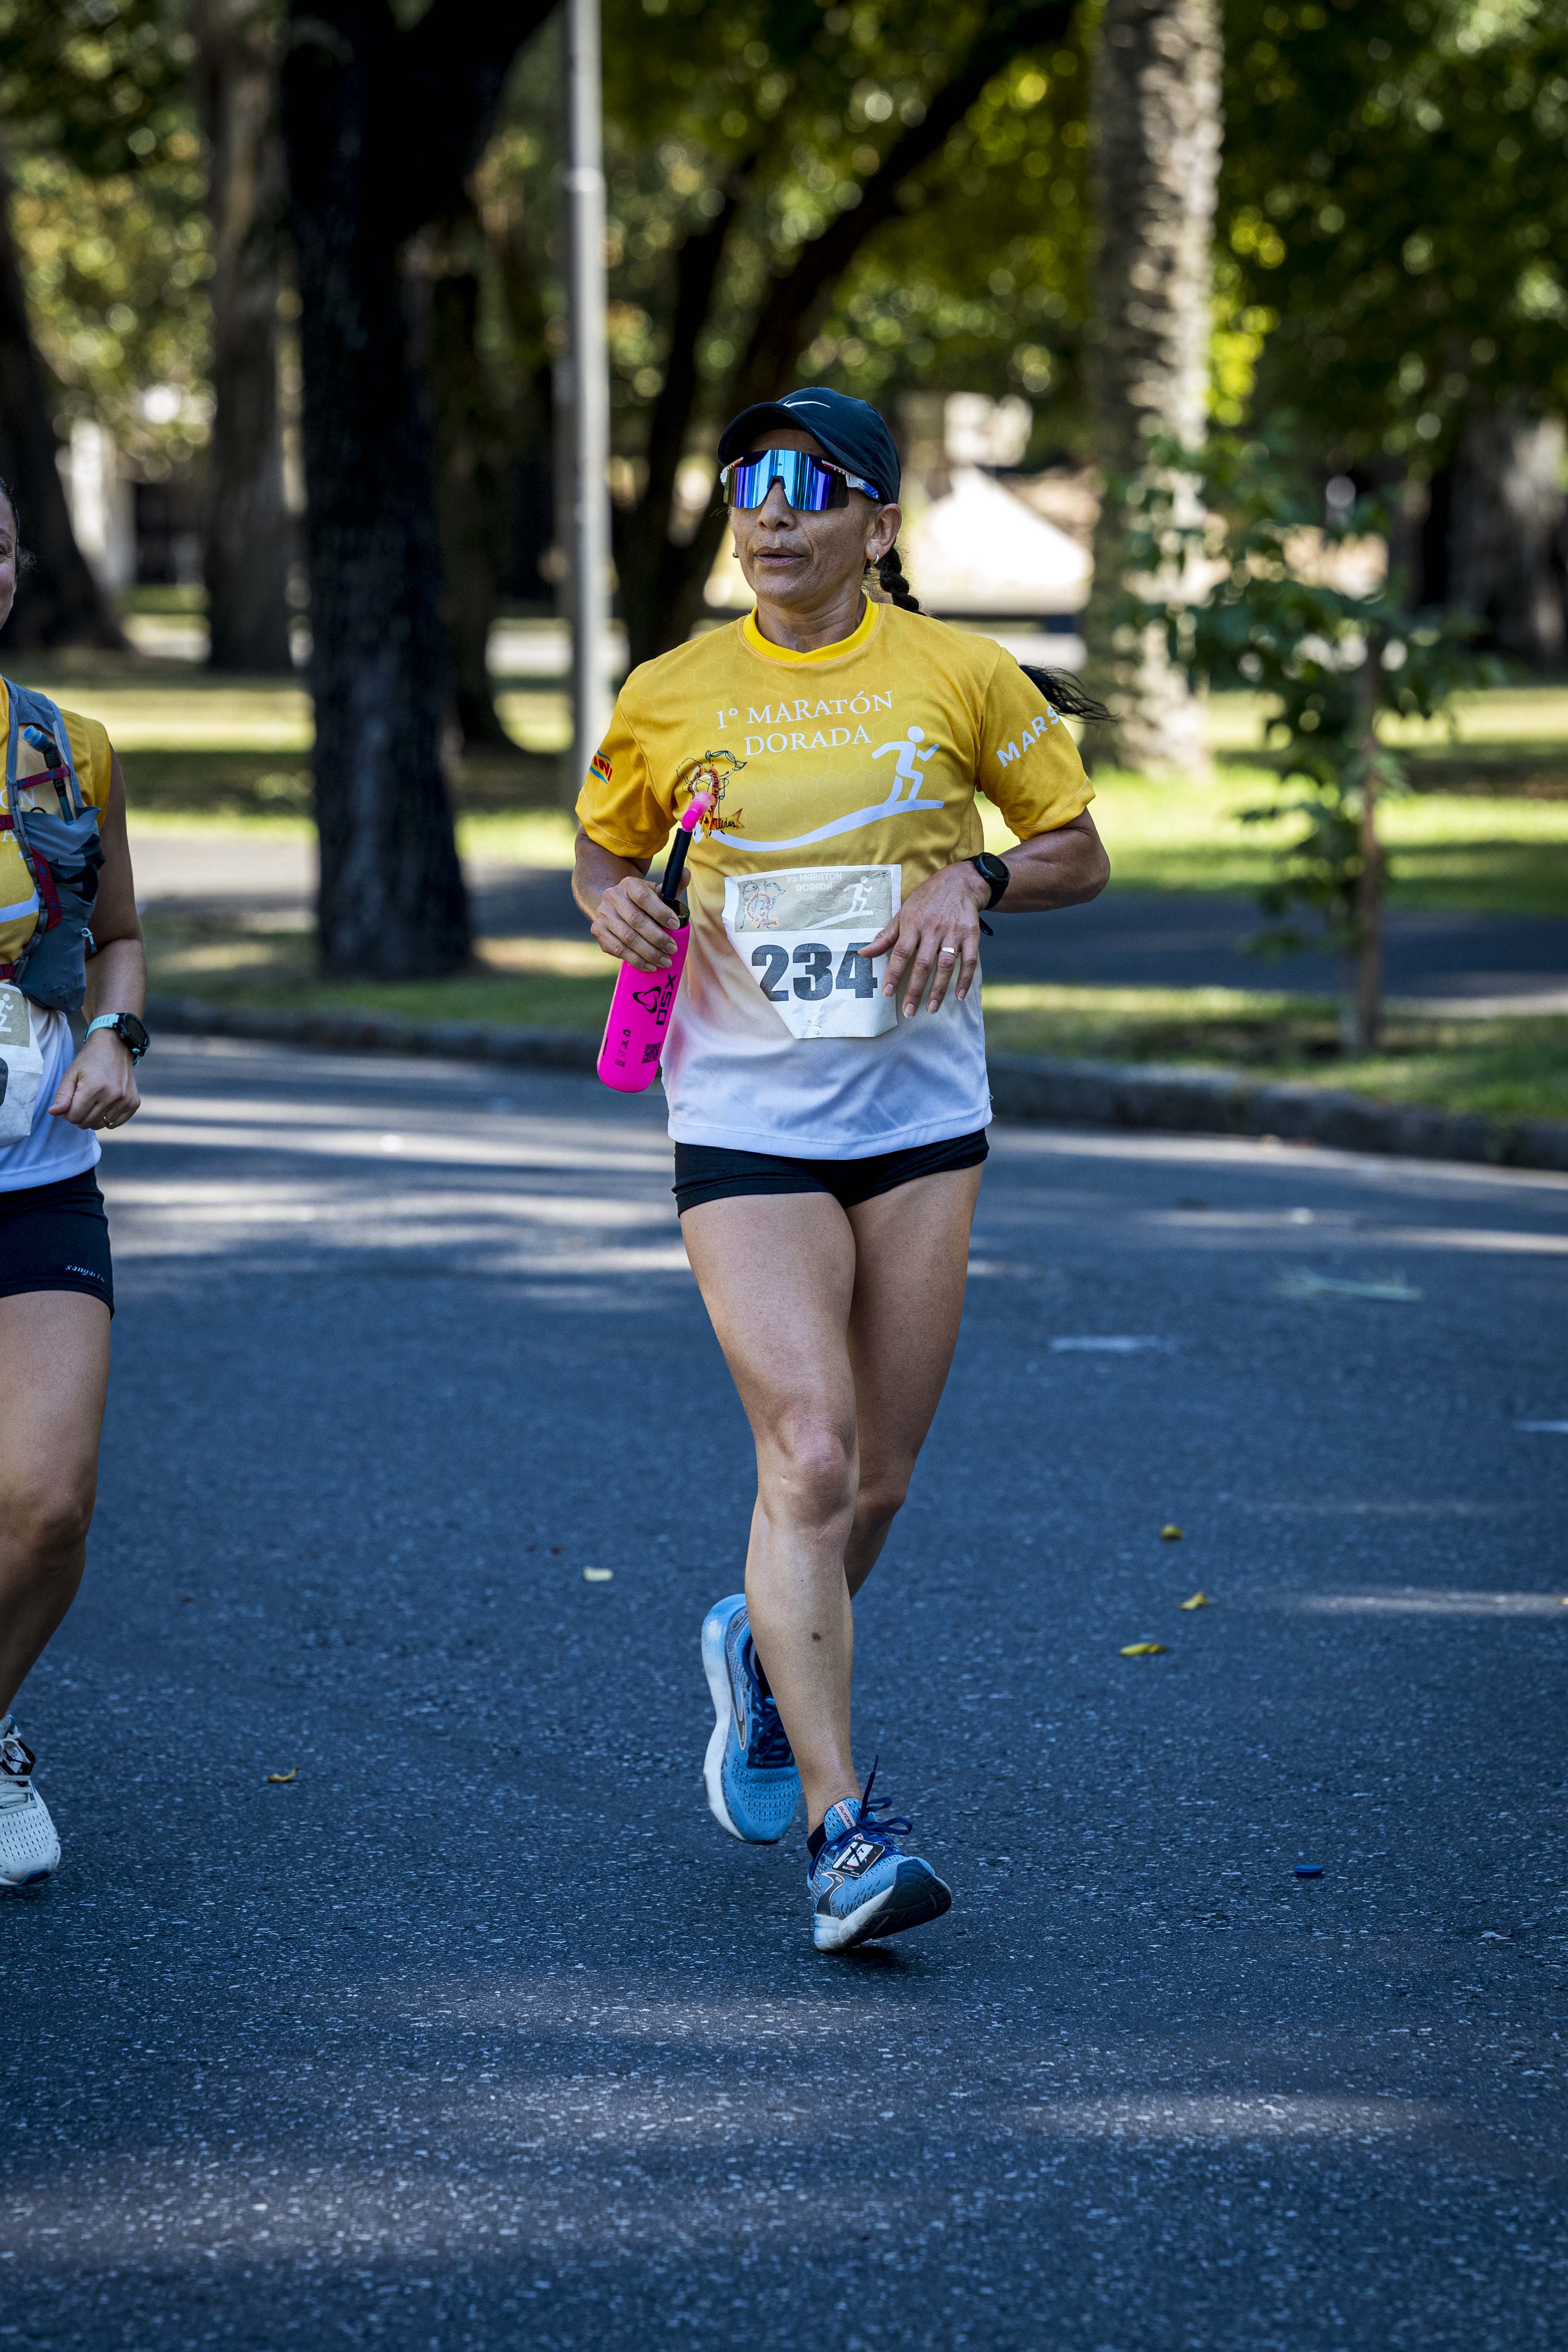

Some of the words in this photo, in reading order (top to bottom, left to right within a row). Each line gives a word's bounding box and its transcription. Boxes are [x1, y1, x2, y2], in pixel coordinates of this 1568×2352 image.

[746, 691, 893, 724] MARATÓN
[744, 724, 873, 756] DORADA
[713, 817, 736, 829] Vidas
[796, 883, 833, 892] DORADA
[751, 942, 878, 1002] 234
